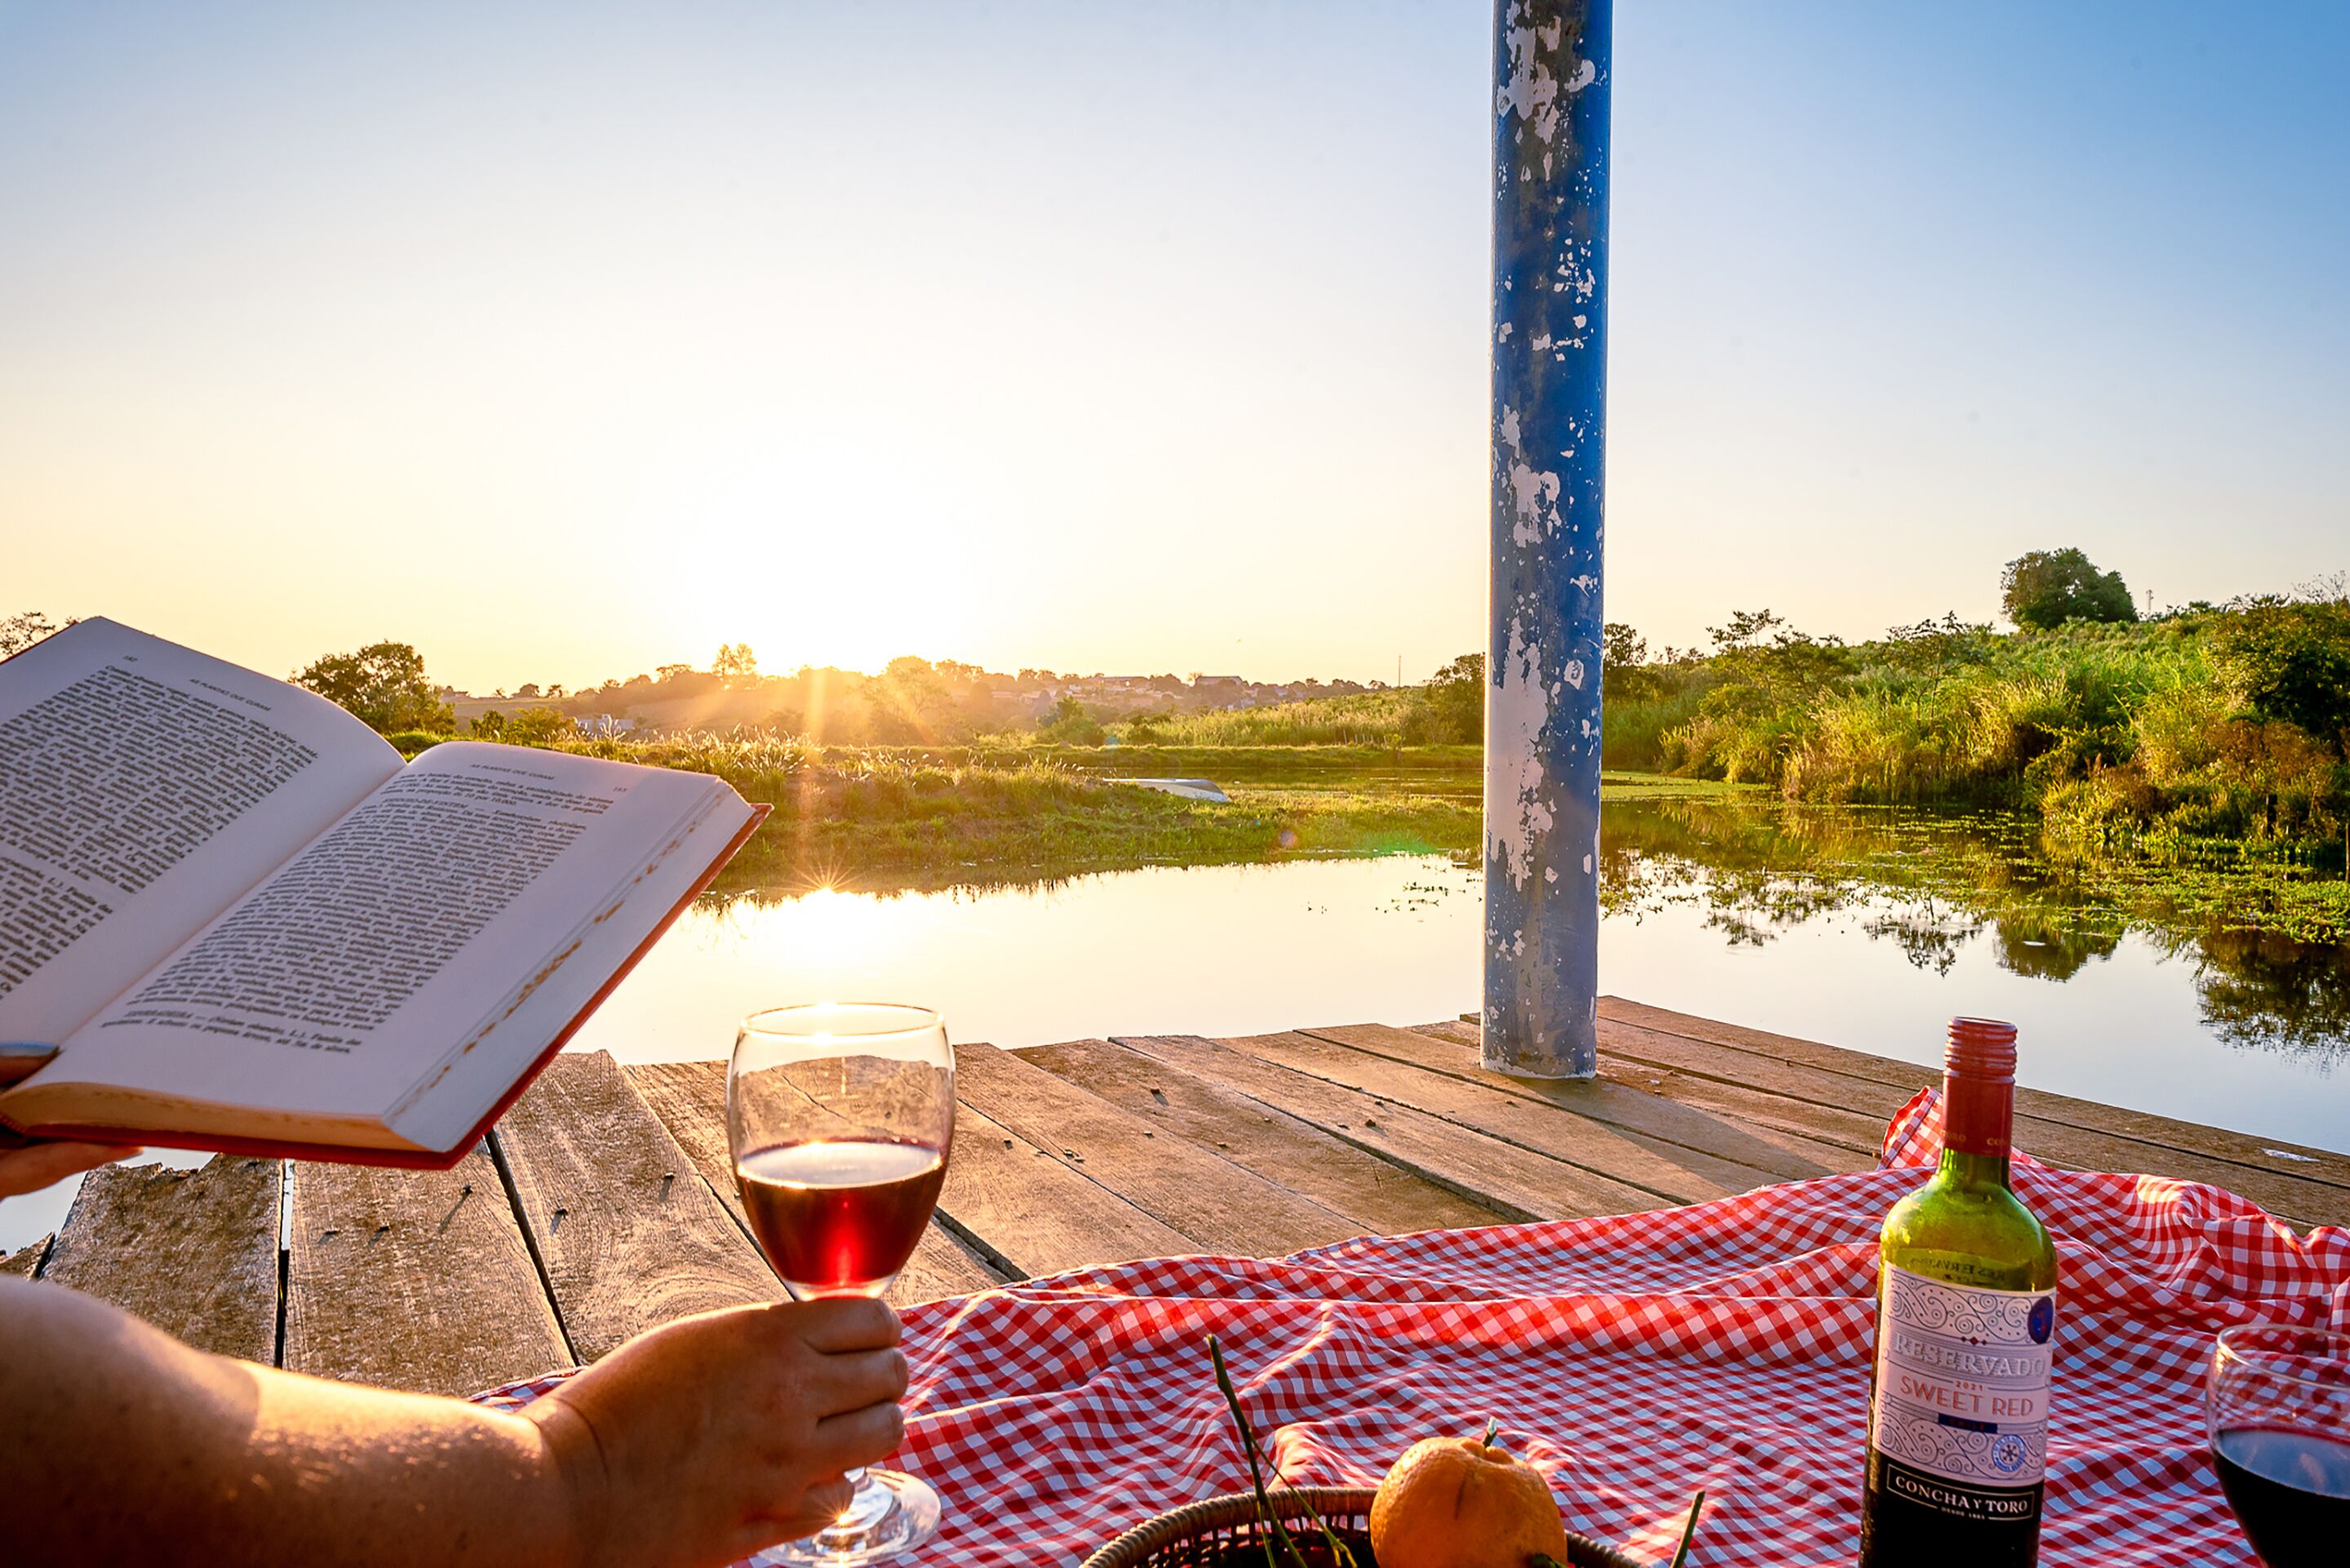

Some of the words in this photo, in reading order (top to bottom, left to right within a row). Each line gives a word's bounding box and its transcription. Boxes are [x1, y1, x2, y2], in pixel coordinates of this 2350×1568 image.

[1896, 1332, 2046, 1377] RESERVADO
[1900, 1375, 1983, 1412] SWEET
[1992, 1397, 2033, 1417] RED
[1956, 1380, 1984, 1391] 2021
[1896, 1476, 1970, 1509] CONCHA
[1973, 1499, 1983, 1509] Y
[1985, 1499, 2028, 1514] TORO
